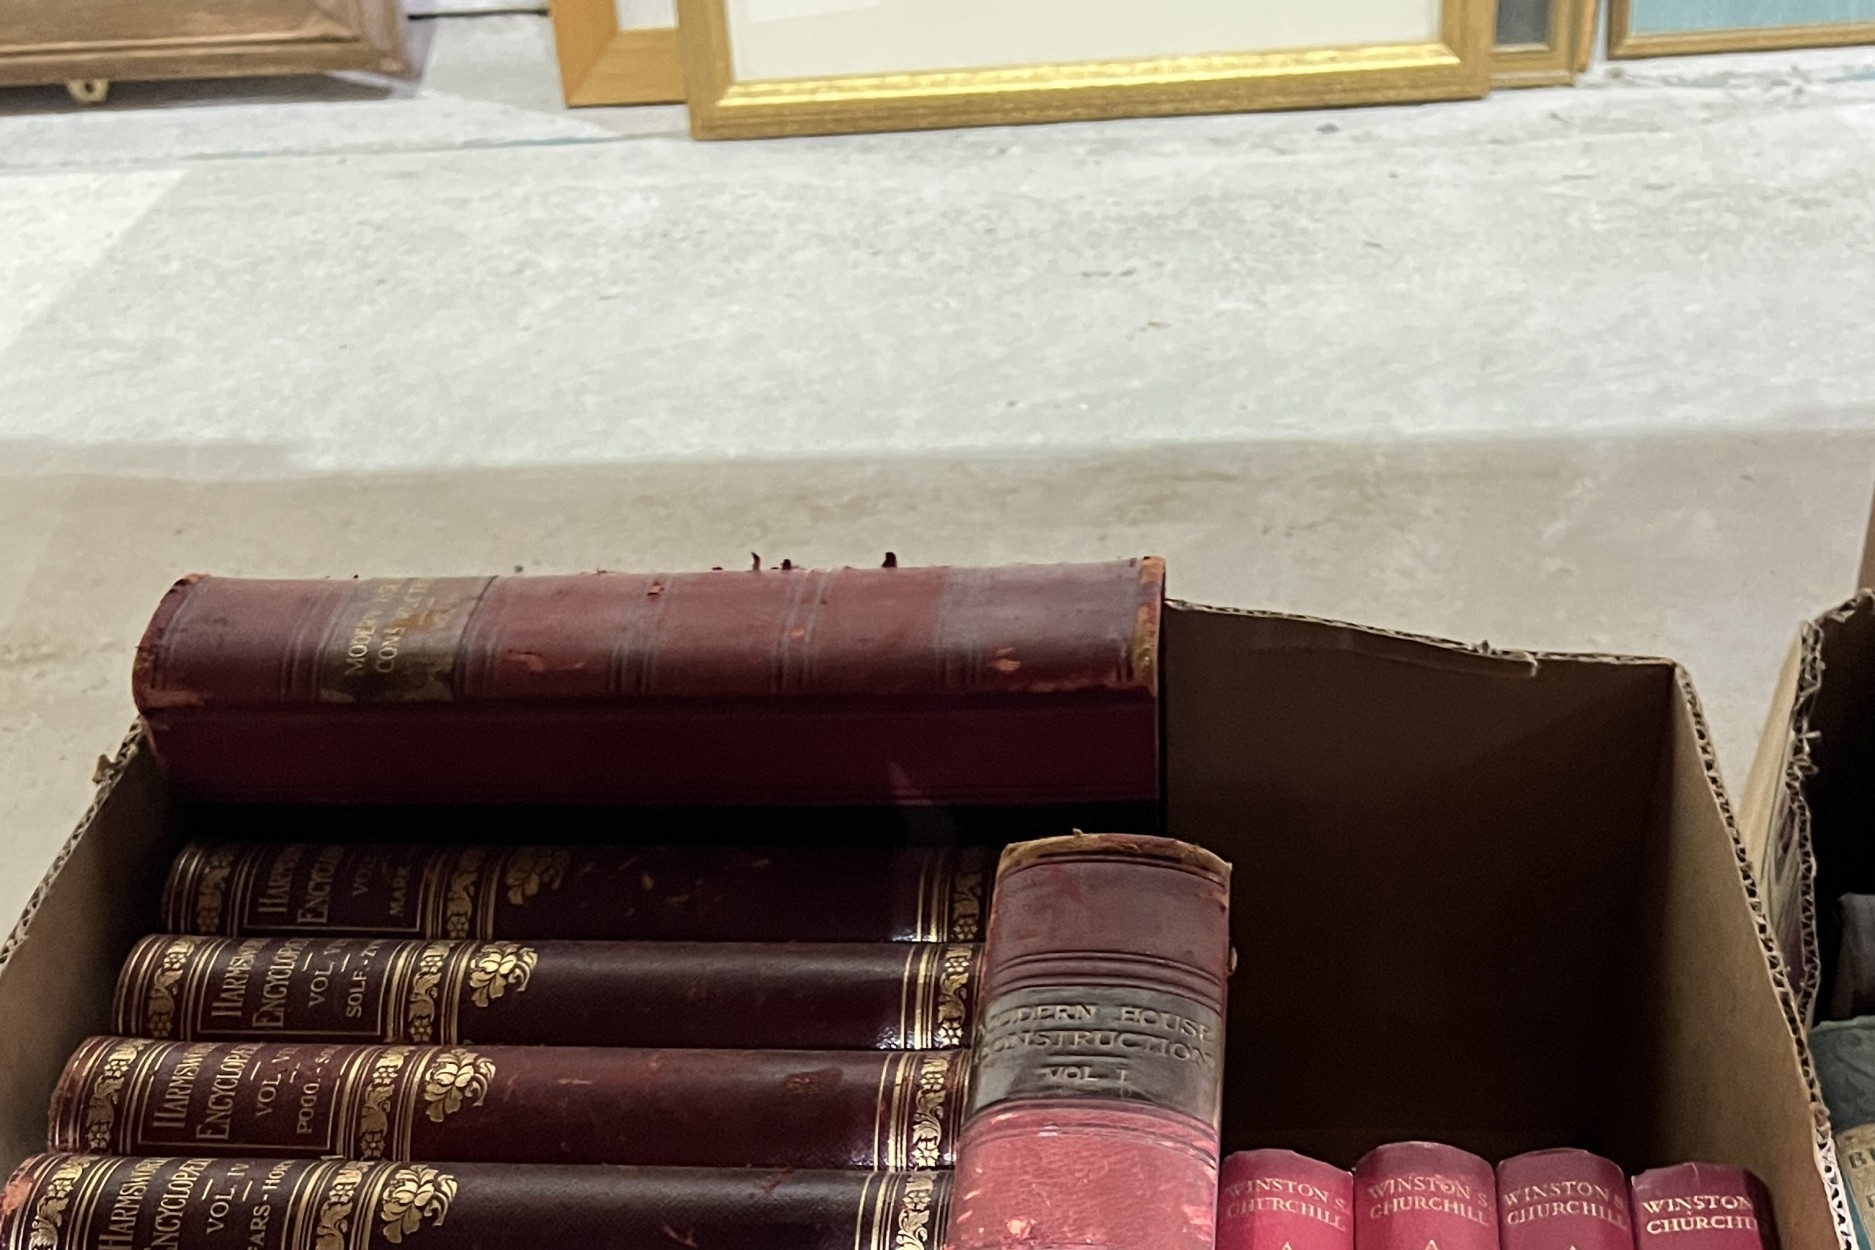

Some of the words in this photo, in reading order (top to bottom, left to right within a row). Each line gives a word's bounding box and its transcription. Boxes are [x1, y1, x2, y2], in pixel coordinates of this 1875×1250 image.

[1118, 1004, 1214, 1043] HOUSE
[1226, 1178, 1329, 1204] WINSTON
[1368, 1175, 1470, 1200] WINSTON
[1503, 1181, 1610, 1207] WINSTON
[1228, 1197, 1346, 1232] CHURCHILL
[1370, 1196, 1490, 1227] CHURCHILL
[1507, 1201, 1627, 1230] CHURCHILL
